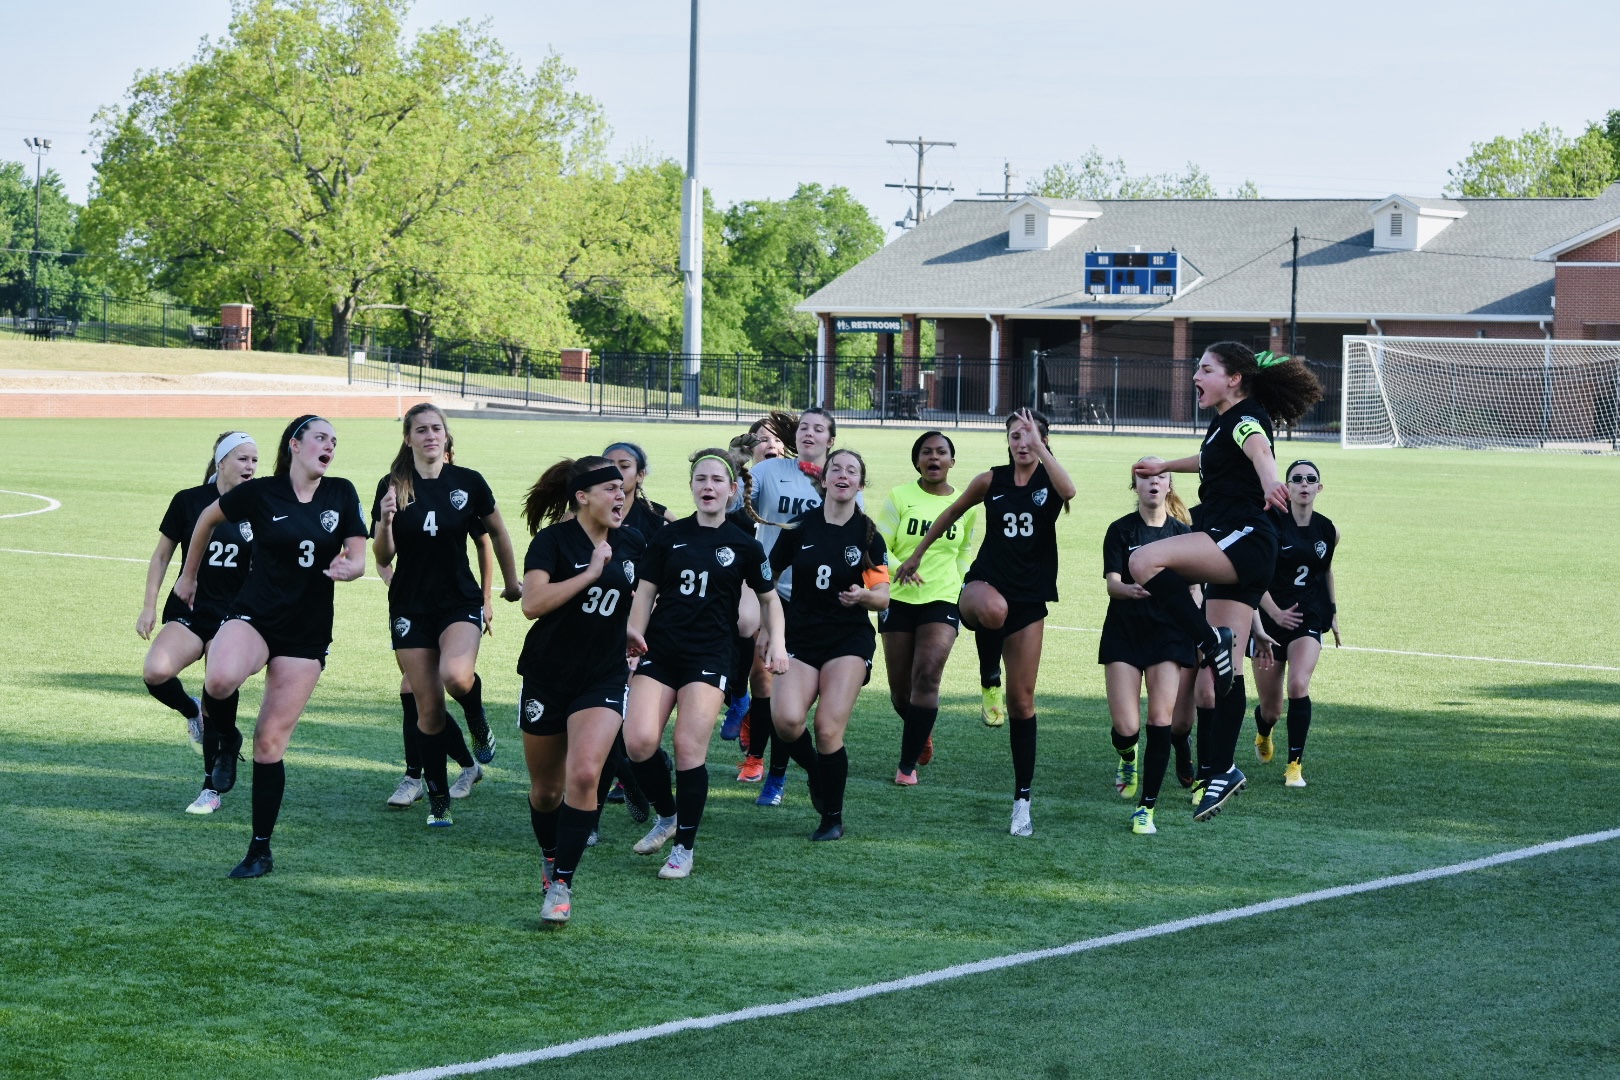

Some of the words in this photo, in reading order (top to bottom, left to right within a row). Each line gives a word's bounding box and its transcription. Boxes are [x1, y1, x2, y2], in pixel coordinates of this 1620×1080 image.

[1152, 255, 1164, 265] SEC
[1120, 285, 1140, 294] PERIOD
[1152, 285, 1174, 294] GUESTS
[850, 320, 901, 330] RESTROOMS
[1238, 423, 1253, 437] C
[777, 495, 825, 515] DKS
[422, 510, 439, 537] 4
[906, 517, 957, 541] DKC
[1002, 512, 1034, 538] 33
[208, 540, 239, 568] 22
[298, 539, 316, 568] 3
[679, 568, 709, 598] 31
[815, 564, 832, 590] 8
[1293, 565, 1309, 586] 2
[581, 585, 621, 617] 30
